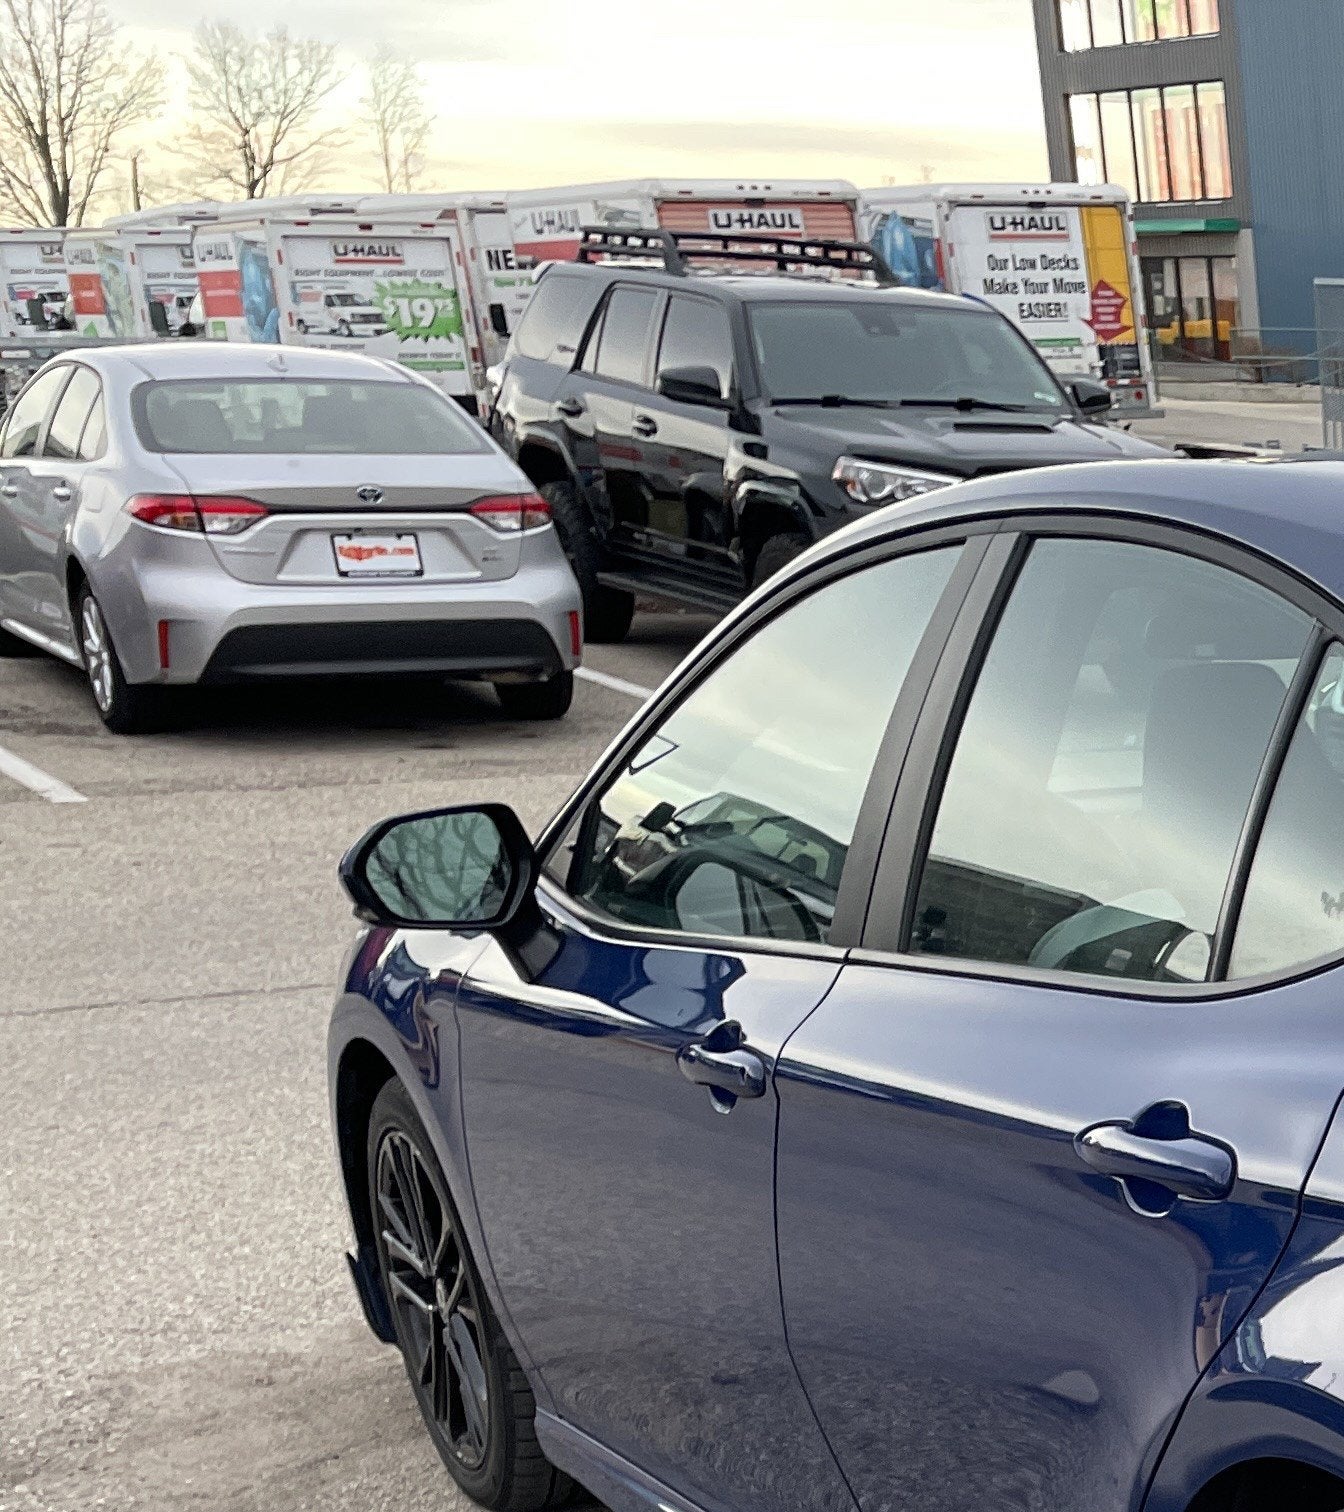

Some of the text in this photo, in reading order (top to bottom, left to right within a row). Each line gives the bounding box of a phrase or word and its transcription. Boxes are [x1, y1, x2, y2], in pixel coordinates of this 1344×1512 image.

[713, 213, 800, 229] U-HAUL
[990, 215, 1067, 231] U-HAUL
[333, 244, 402, 257] U-HAUL
[987, 253, 1080, 271] Our Low Decks
[983, 277, 1086, 295] Make Your Move
[1018, 301, 1068, 319] EASIER!
